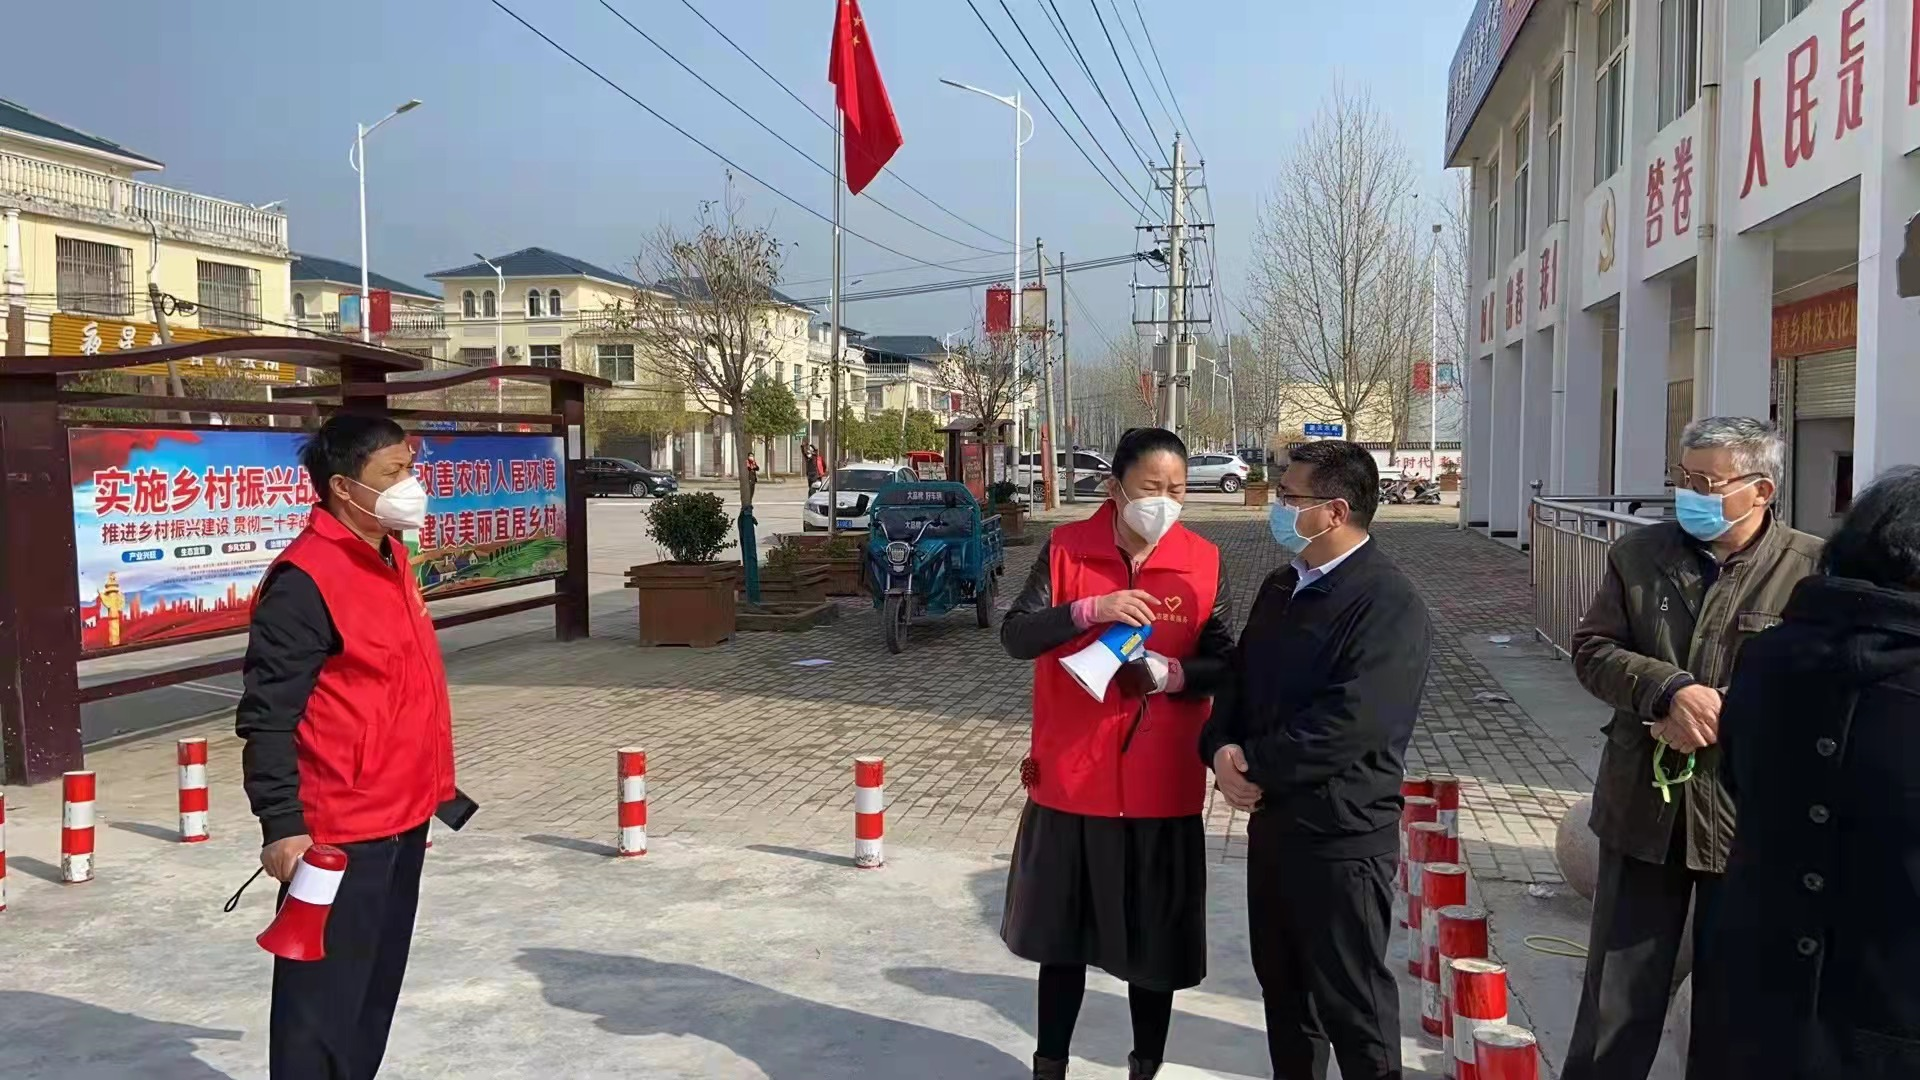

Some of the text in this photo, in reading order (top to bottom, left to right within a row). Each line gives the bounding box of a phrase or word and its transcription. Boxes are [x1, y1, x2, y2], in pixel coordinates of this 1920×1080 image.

[1645, 135, 1694, 249] 答卷
[414, 457, 557, 499] 改善农村人居环境
[101, 517, 230, 545] 推进乡村振兴建设
[418, 503, 557, 552] 建设美丽宜居乡村
